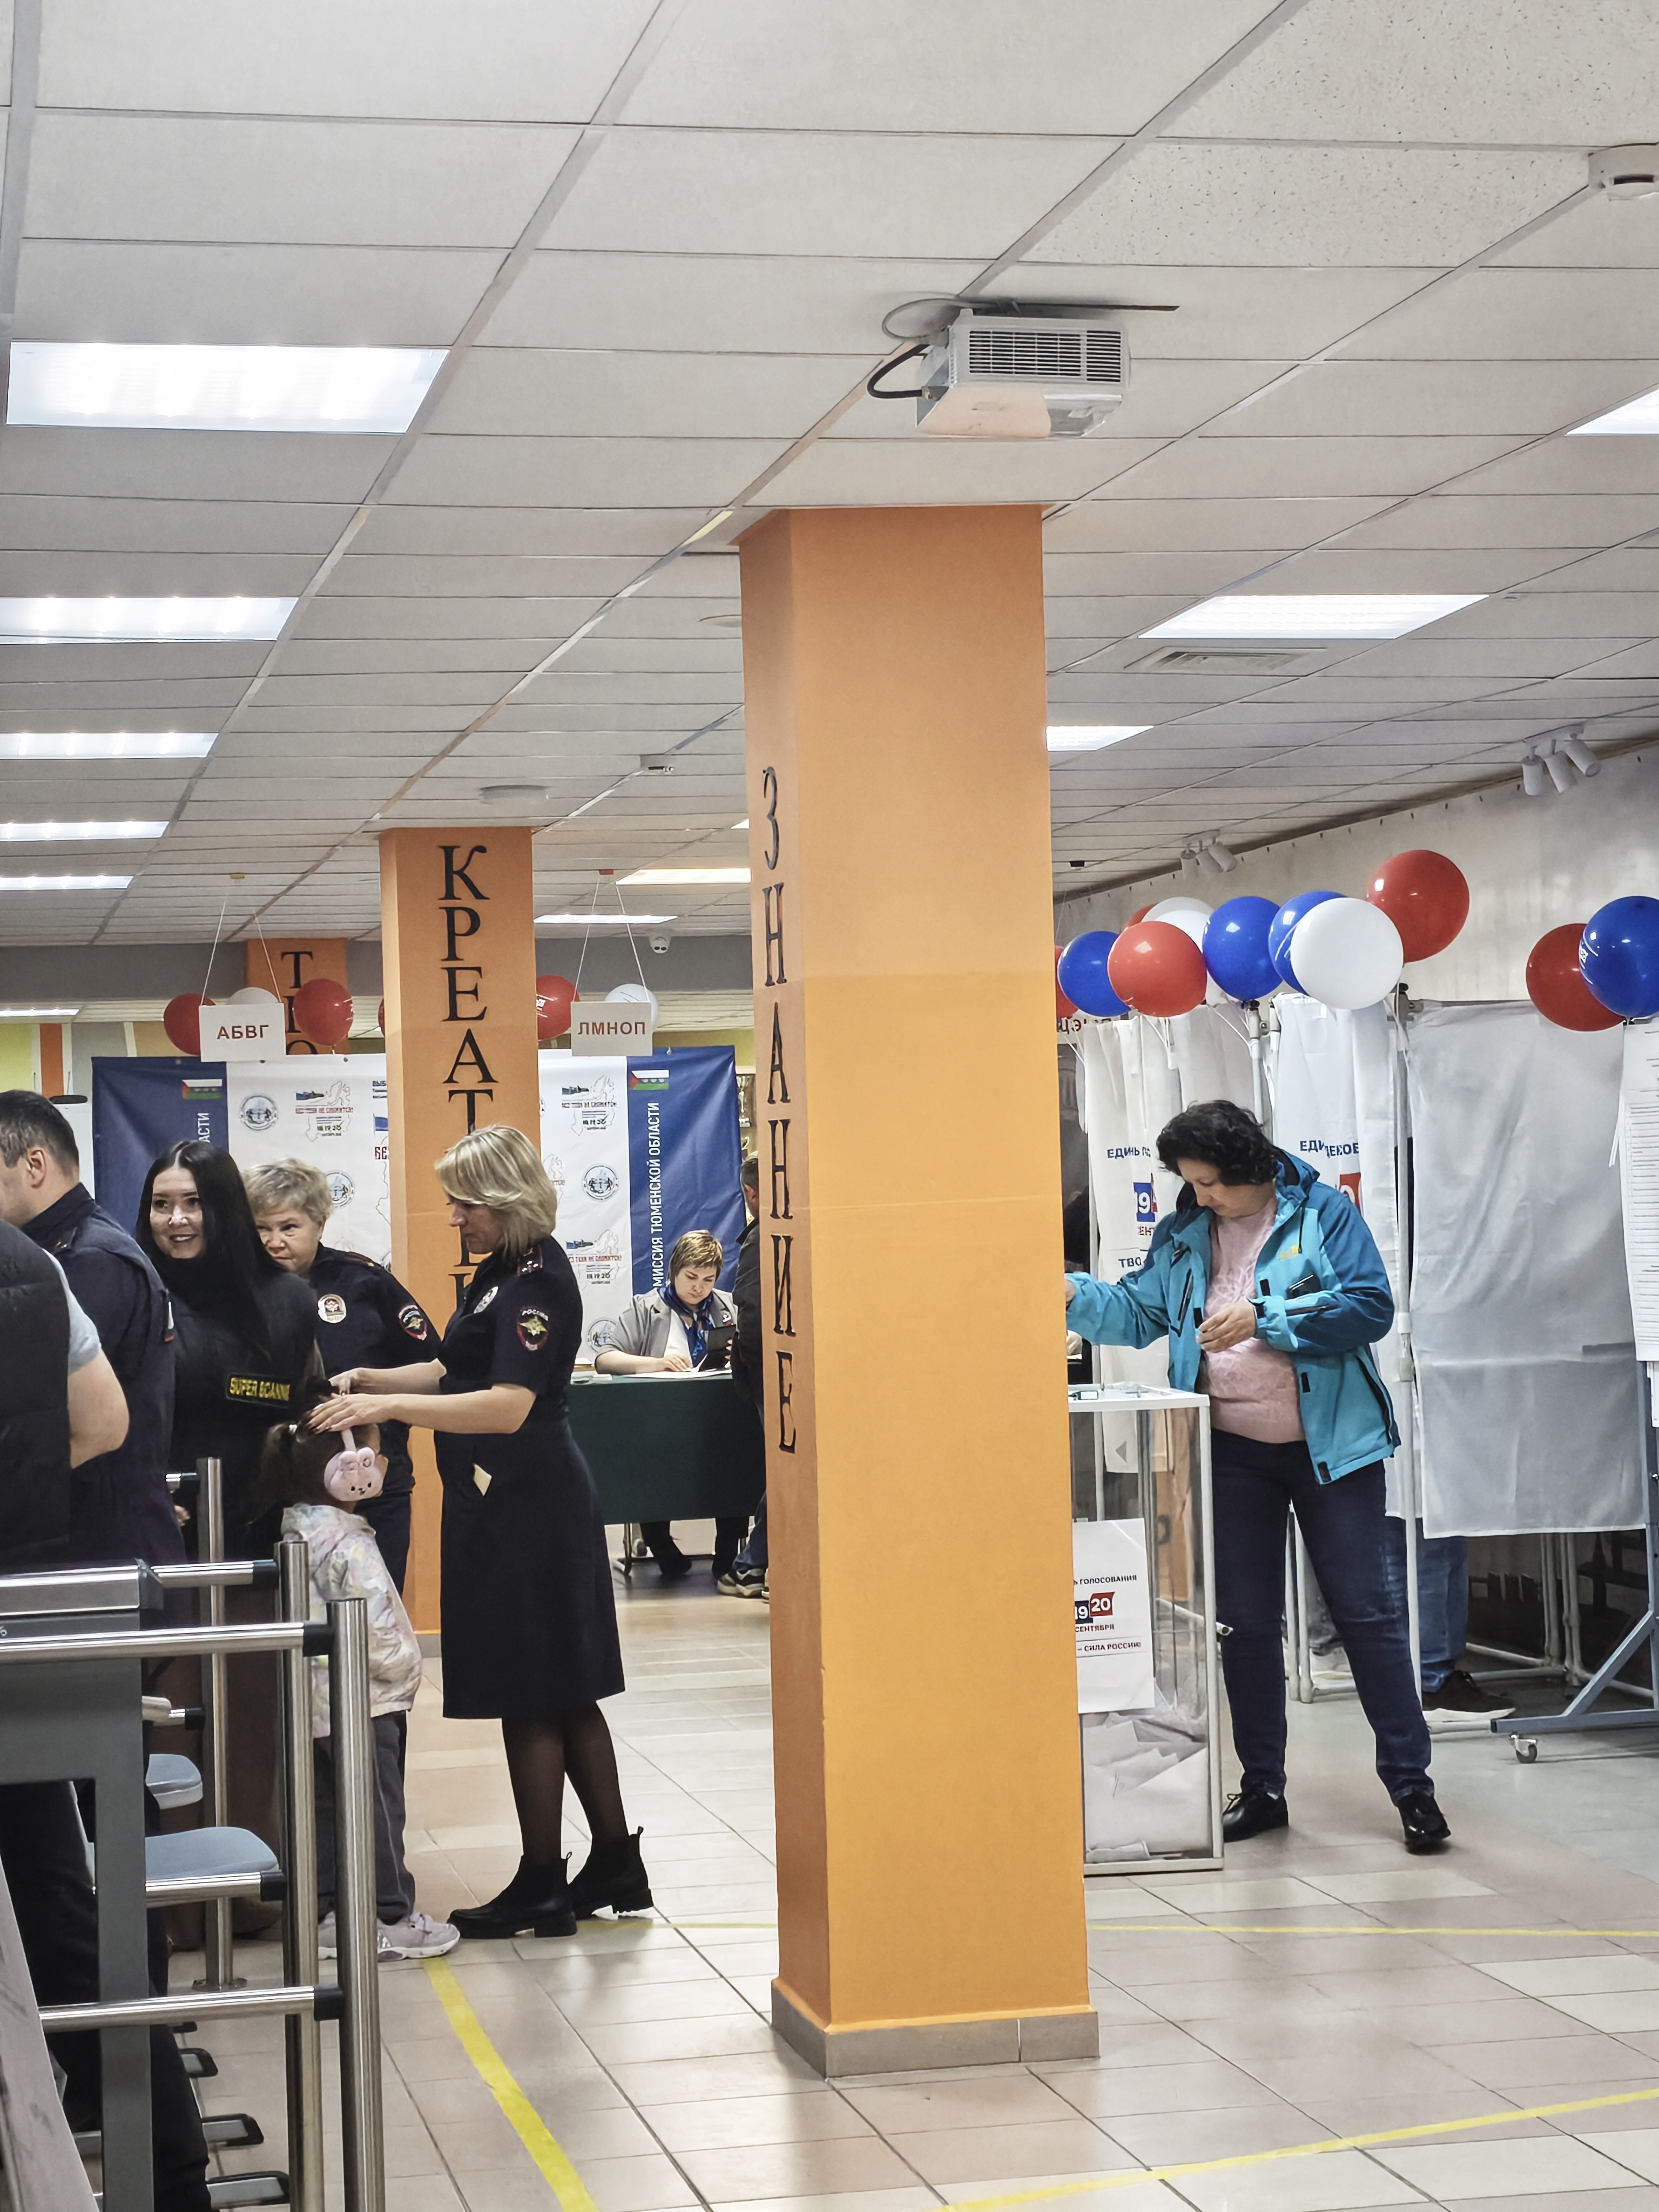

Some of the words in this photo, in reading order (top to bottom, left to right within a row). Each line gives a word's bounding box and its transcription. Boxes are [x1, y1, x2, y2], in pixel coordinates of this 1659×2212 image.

[217, 1025, 269, 1040] АБВГ
[578, 1022, 645, 1035] ЛМНОП
[763, 766, 799, 1454] ЗНАНИЕ
[647, 1103, 661, 1156] ОБЛАСТИ
[646, 1161, 663, 1233] ТЮМЕНСКОЙ
[1080, 1575, 1137, 1585] ГОЛОСОВАНИЯ
[1091, 1597, 1111, 1612] 20
